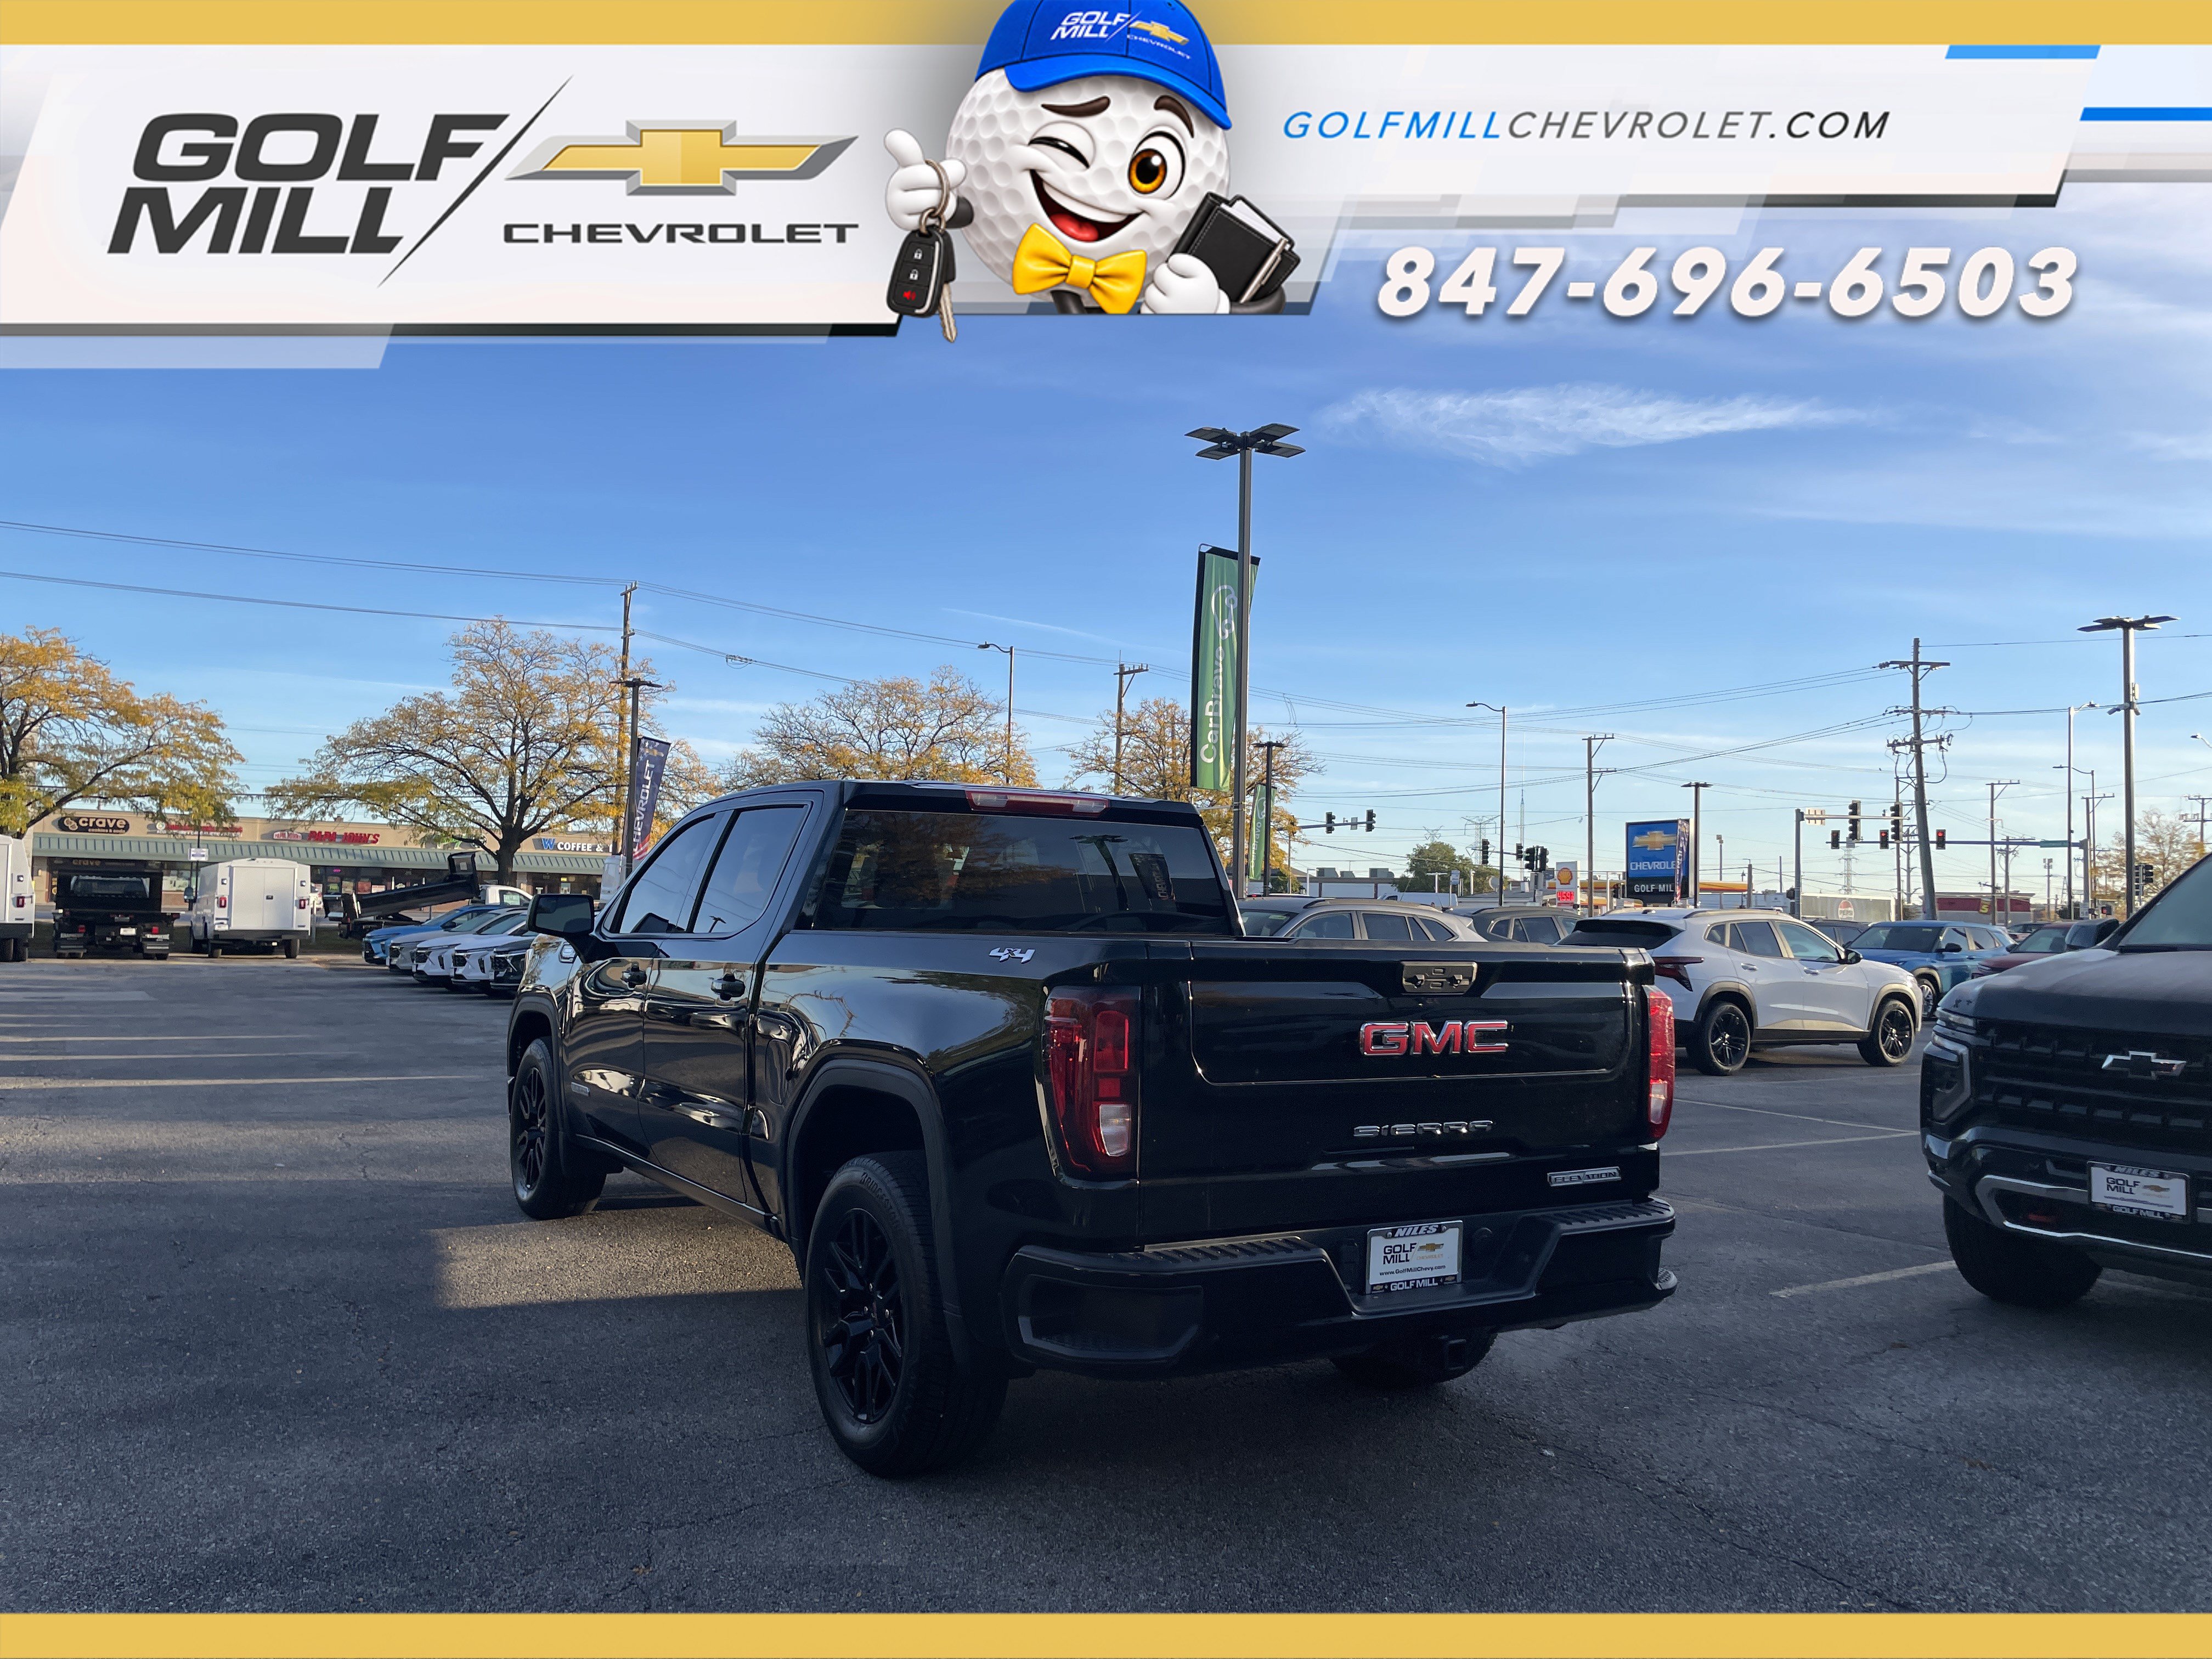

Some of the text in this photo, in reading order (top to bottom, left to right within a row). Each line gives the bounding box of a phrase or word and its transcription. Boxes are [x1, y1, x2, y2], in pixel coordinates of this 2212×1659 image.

[1200, 646, 1224, 763] CarBravo
[78, 817, 126, 828] crave
[307, 831, 337, 842] PAPA
[541, 838, 556, 850] W
[557, 842, 592, 851] COFFEE
[595, 844, 603, 852] &
[1630, 861, 1677, 871] CHEVROLE
[1634, 884, 1675, 893] GOLF MIL
[1359, 1020, 1509, 1056] GMC
[1353, 1120, 1493, 1137] SIERRA
[1554, 1171, 1617, 1183] ELEVATION
[2114, 1166, 2161, 1177] NILES
[2106, 1177, 2141, 1188] GOLF
[2107, 1184, 2136, 1195] MILL
[1394, 1224, 1439, 1237] NILES
[1384, 1243, 1417, 1255] GOLF
[1383, 1253, 1410, 1265] MILL
[1379, 1265, 1446, 1276] www.GolfMillChevy.com
[1390, 1278, 1438, 1291] GOLF MILL
